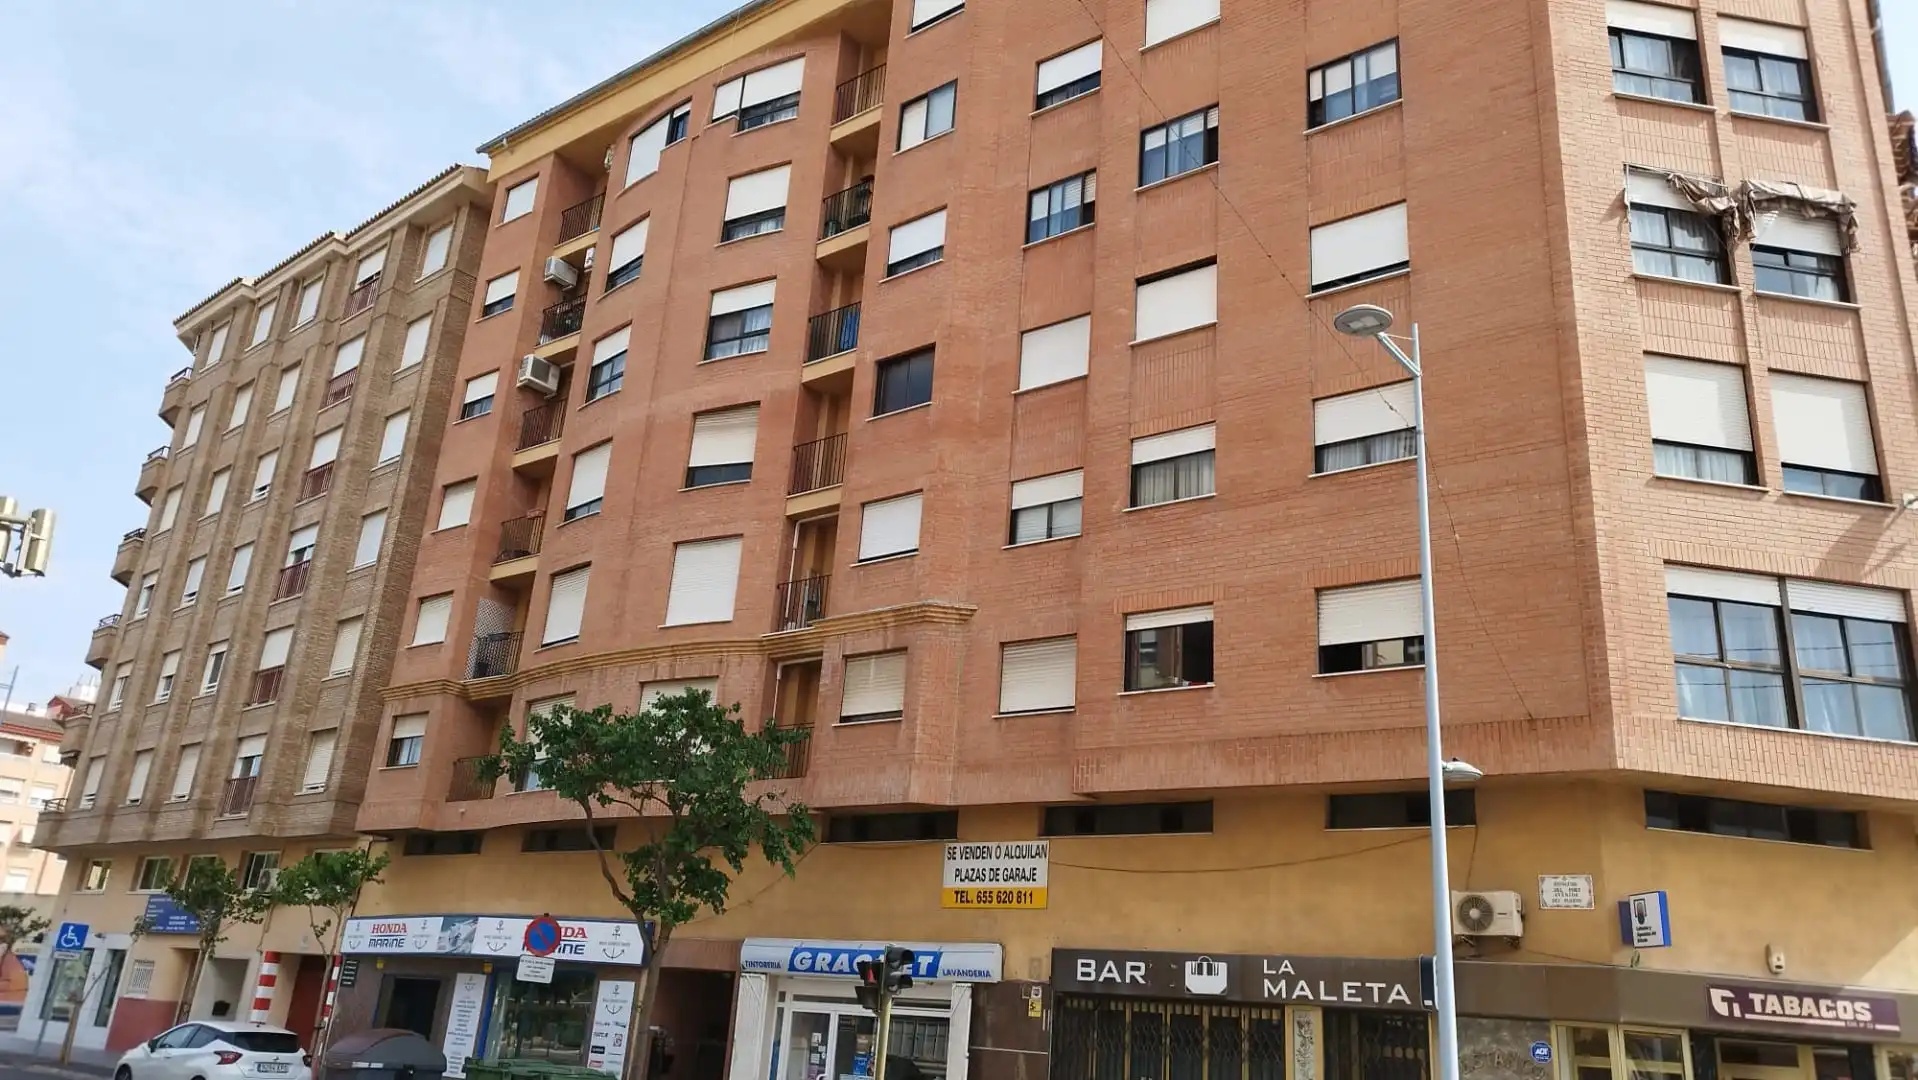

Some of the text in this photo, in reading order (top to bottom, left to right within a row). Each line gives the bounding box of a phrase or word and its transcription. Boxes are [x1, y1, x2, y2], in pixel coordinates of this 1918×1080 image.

[947, 846, 957, 860] SE
[960, 845, 992, 860] VENDEN
[1003, 843, 1048, 860] ALQUILAN
[954, 867, 1037, 882] PLAZAS DE GARAJE
[954, 890, 1033, 904] TEL. 655 620 811
[371, 922, 408, 934] HONDA
[1076, 958, 1147, 984] BAR
[1263, 958, 1296, 975] LA
[1263, 978, 1412, 1005] MALETA
[1748, 992, 1873, 1022] TABACOS
